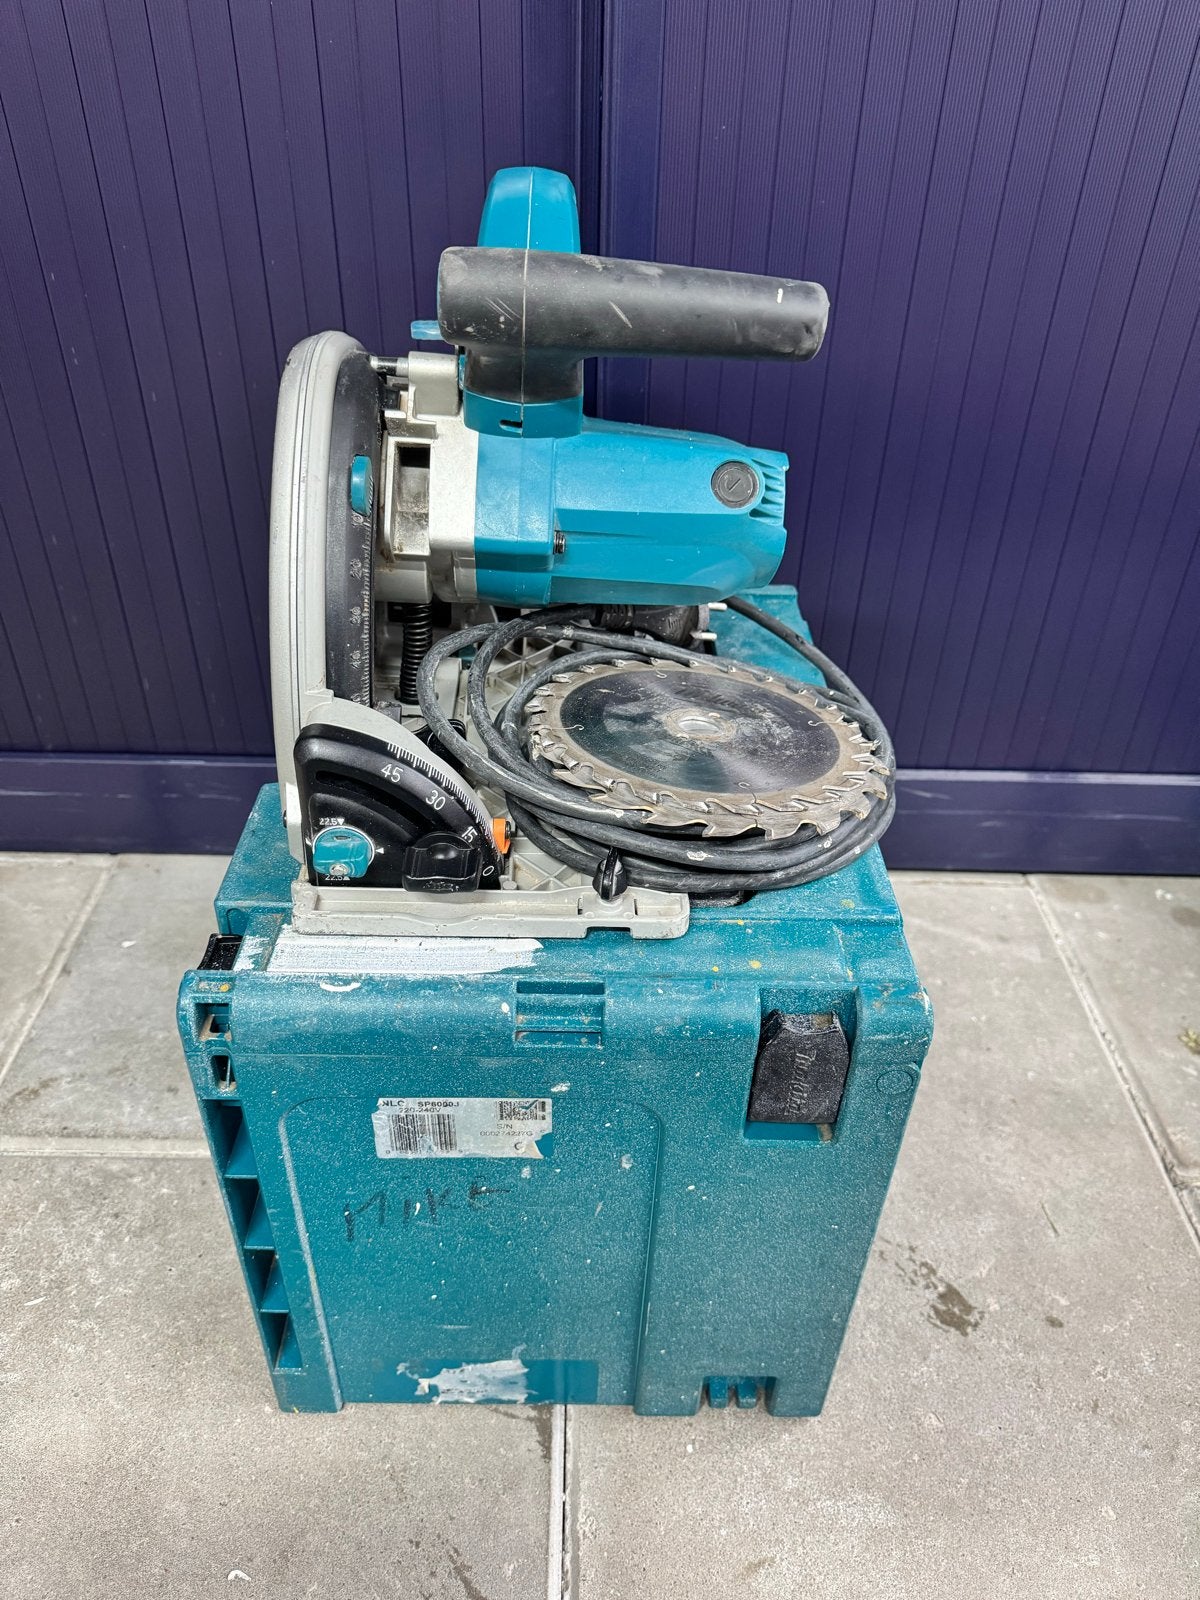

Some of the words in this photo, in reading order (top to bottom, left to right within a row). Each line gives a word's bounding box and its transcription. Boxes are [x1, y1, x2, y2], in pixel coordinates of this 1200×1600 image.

[318, 817, 338, 826] 22.5
[380, 763, 403, 783] 45
[425, 789, 446, 811] 30
[461, 825, 478, 843] 15
[482, 865, 495, 877] 0
